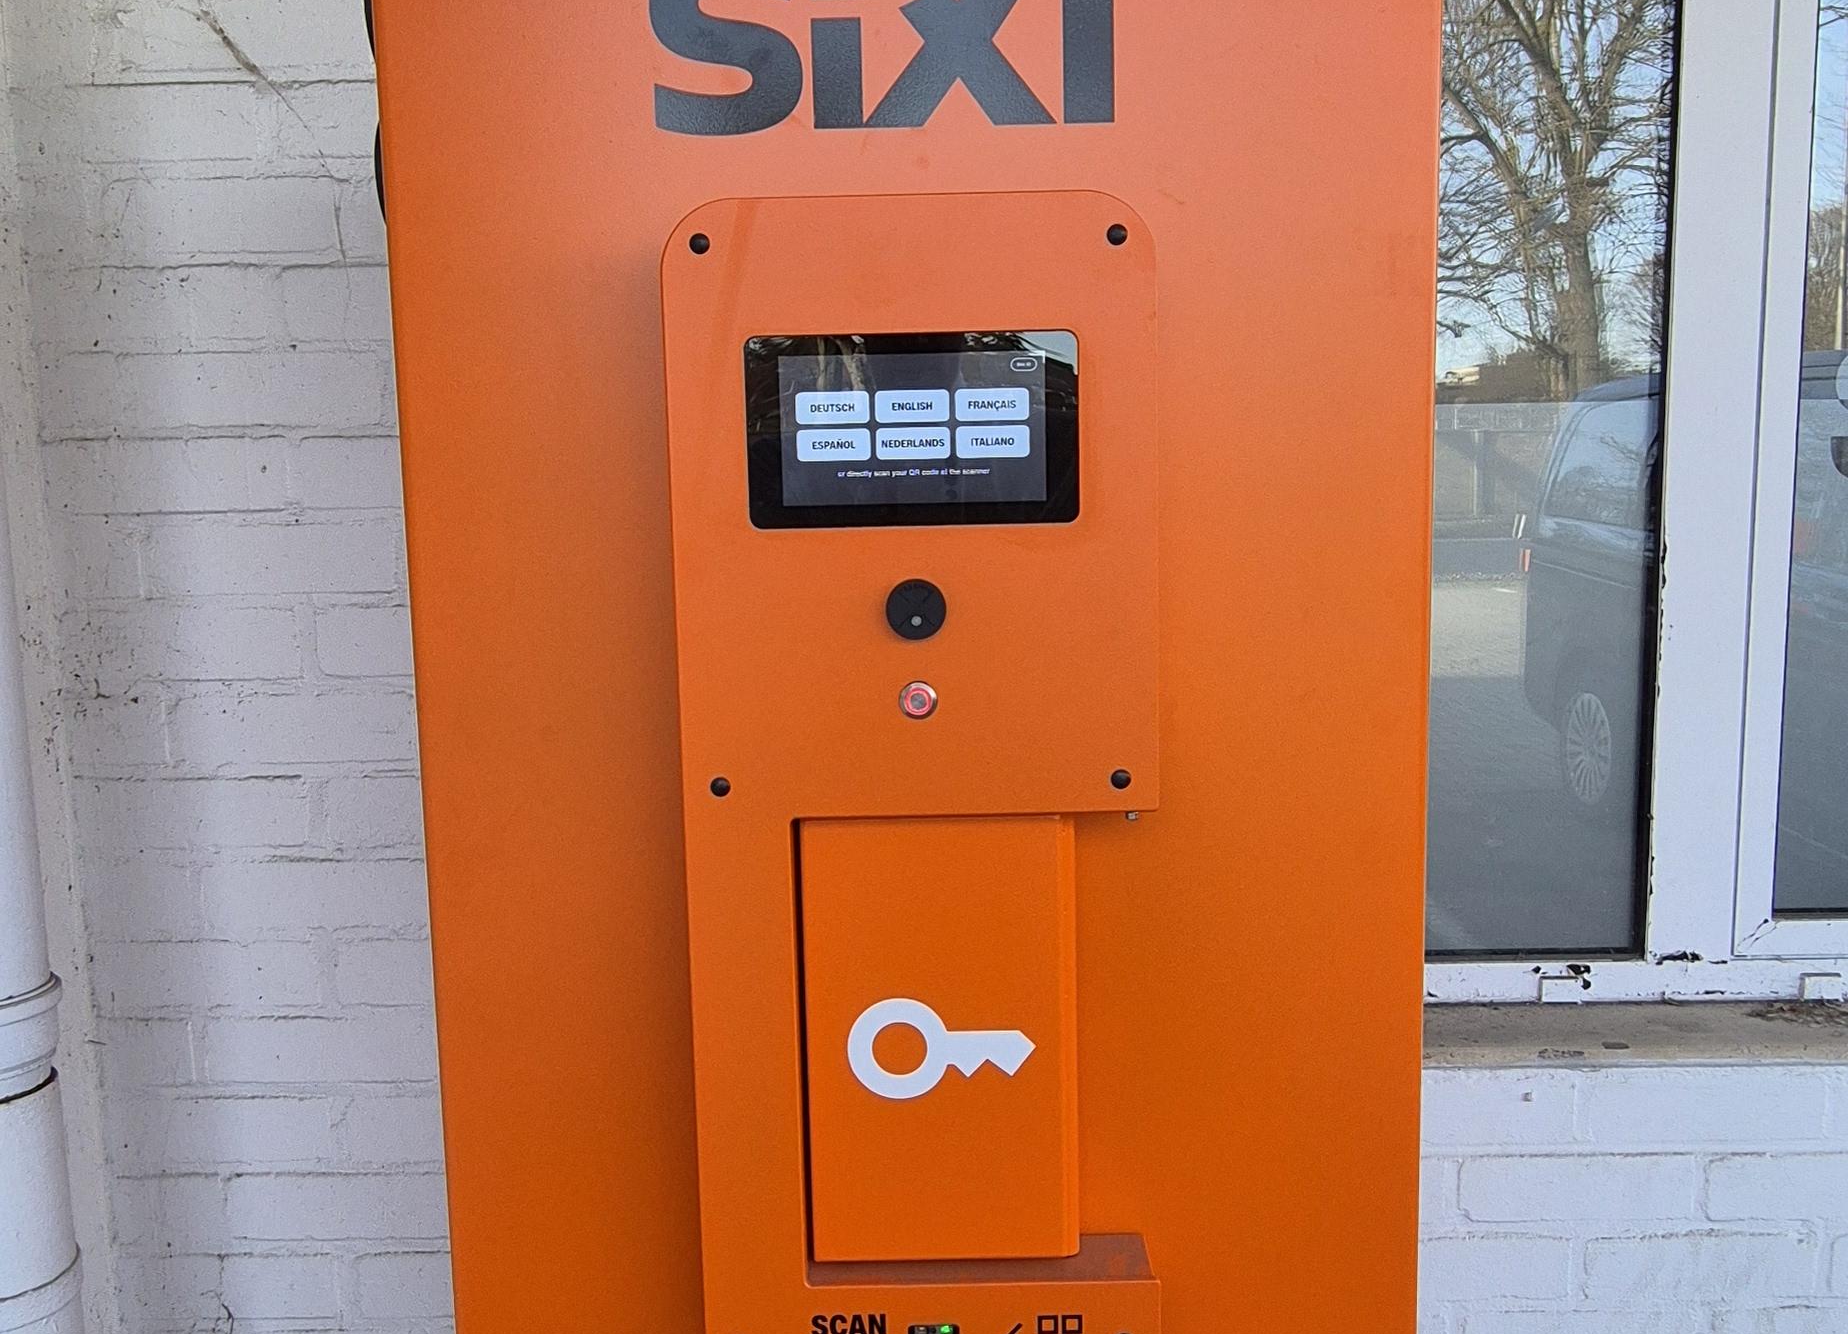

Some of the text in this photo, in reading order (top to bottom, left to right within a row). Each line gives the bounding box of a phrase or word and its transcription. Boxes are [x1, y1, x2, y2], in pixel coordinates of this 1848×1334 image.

[810, 403, 855, 413] DEUTSCH
[891, 401, 933, 411] ENGLISH
[967, 399, 1017, 411] FRANÇAIS
[811, 438, 856, 450] ESPAÑOL
[881, 438, 945, 449] NEDERLANDS
[970, 437, 1015, 447] ITALIANO
[846, 470, 872, 478] directly
[891, 470, 907, 478] your
[908, 468, 920, 476] QR
